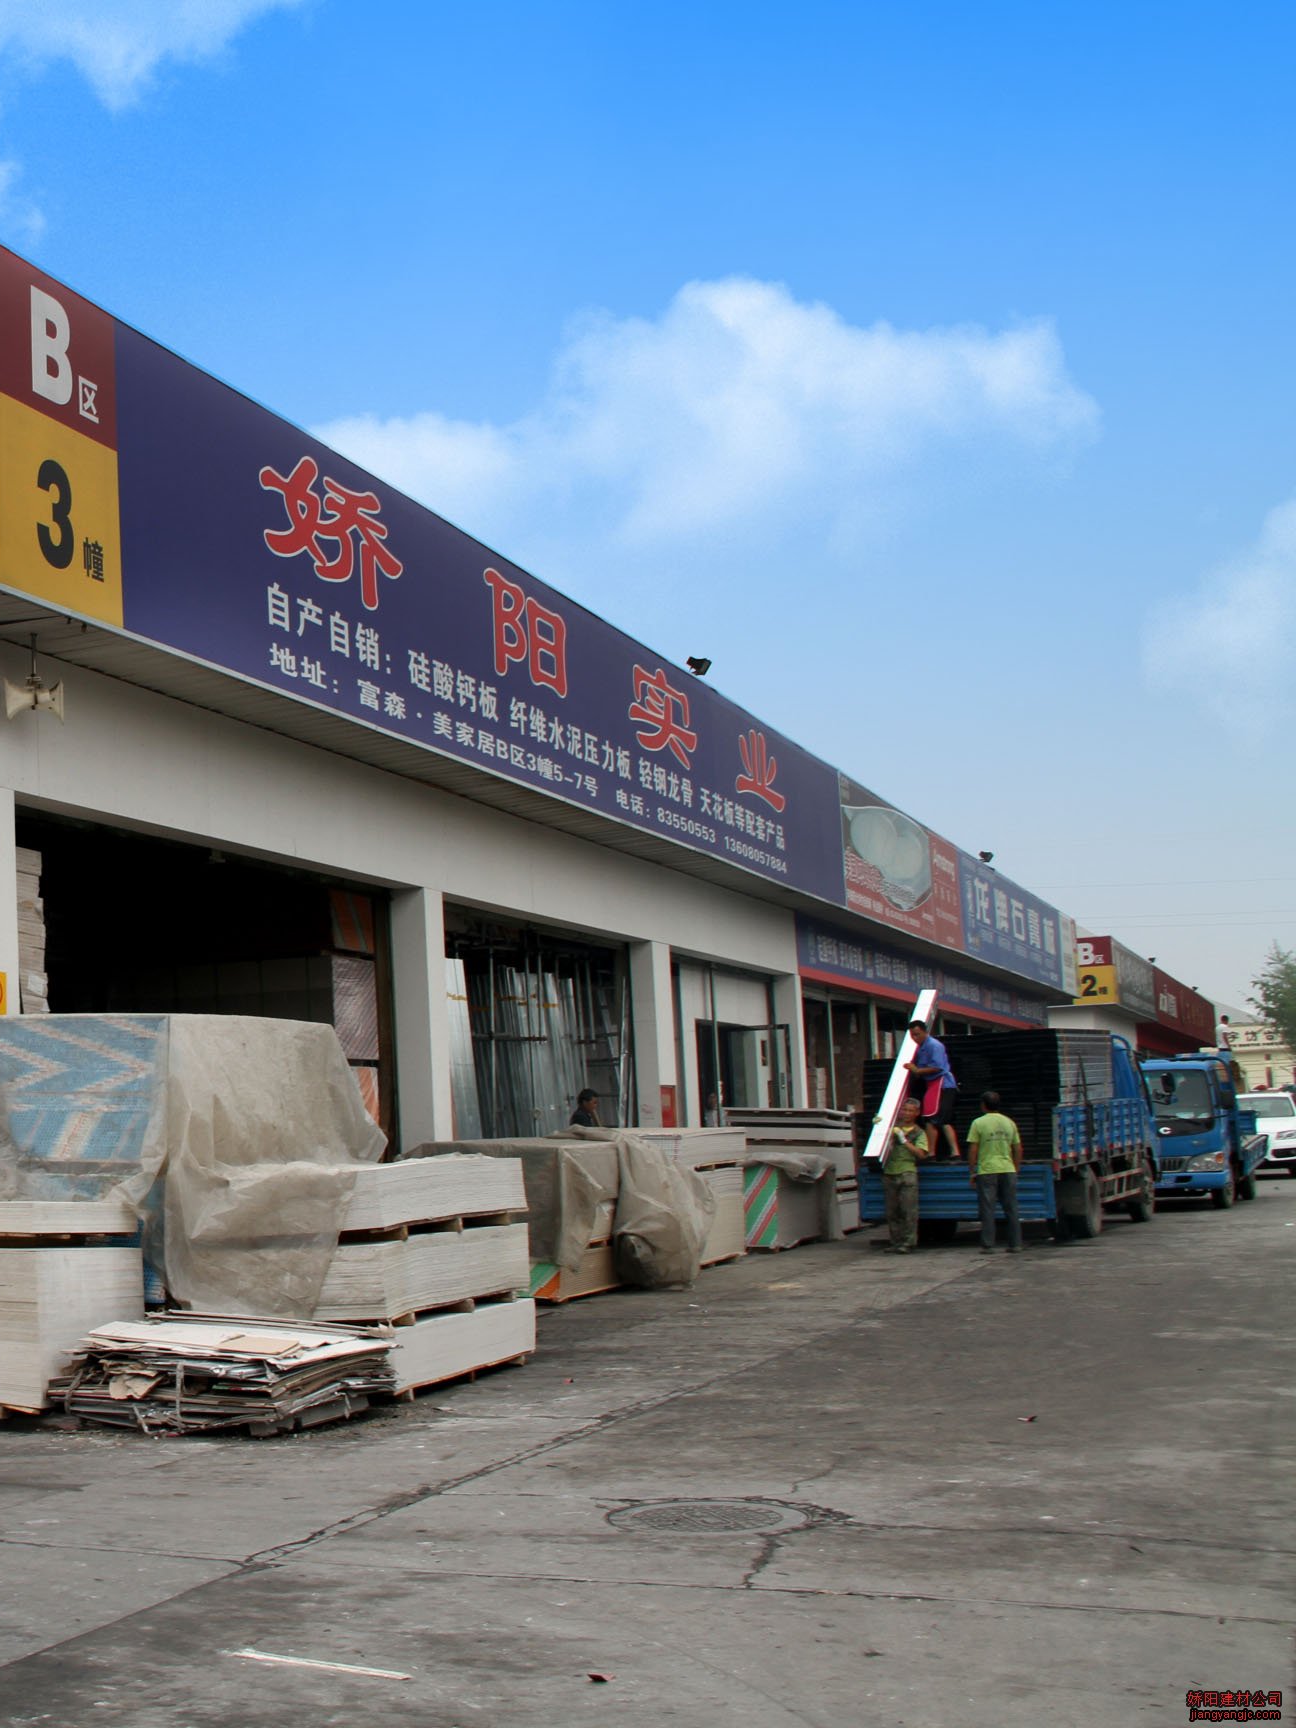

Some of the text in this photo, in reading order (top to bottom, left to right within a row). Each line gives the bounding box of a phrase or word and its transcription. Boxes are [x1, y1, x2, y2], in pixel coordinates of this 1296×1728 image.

[30, 284, 100, 424] B区
[36, 459, 105, 582] 3幢
[259, 455, 785, 813] 娇阳实业
[510, 696, 632, 780] 纤维水泥压力板
[638, 757, 693, 808] 轻钢龙骨
[724, 836, 787, 874] 13608057884
